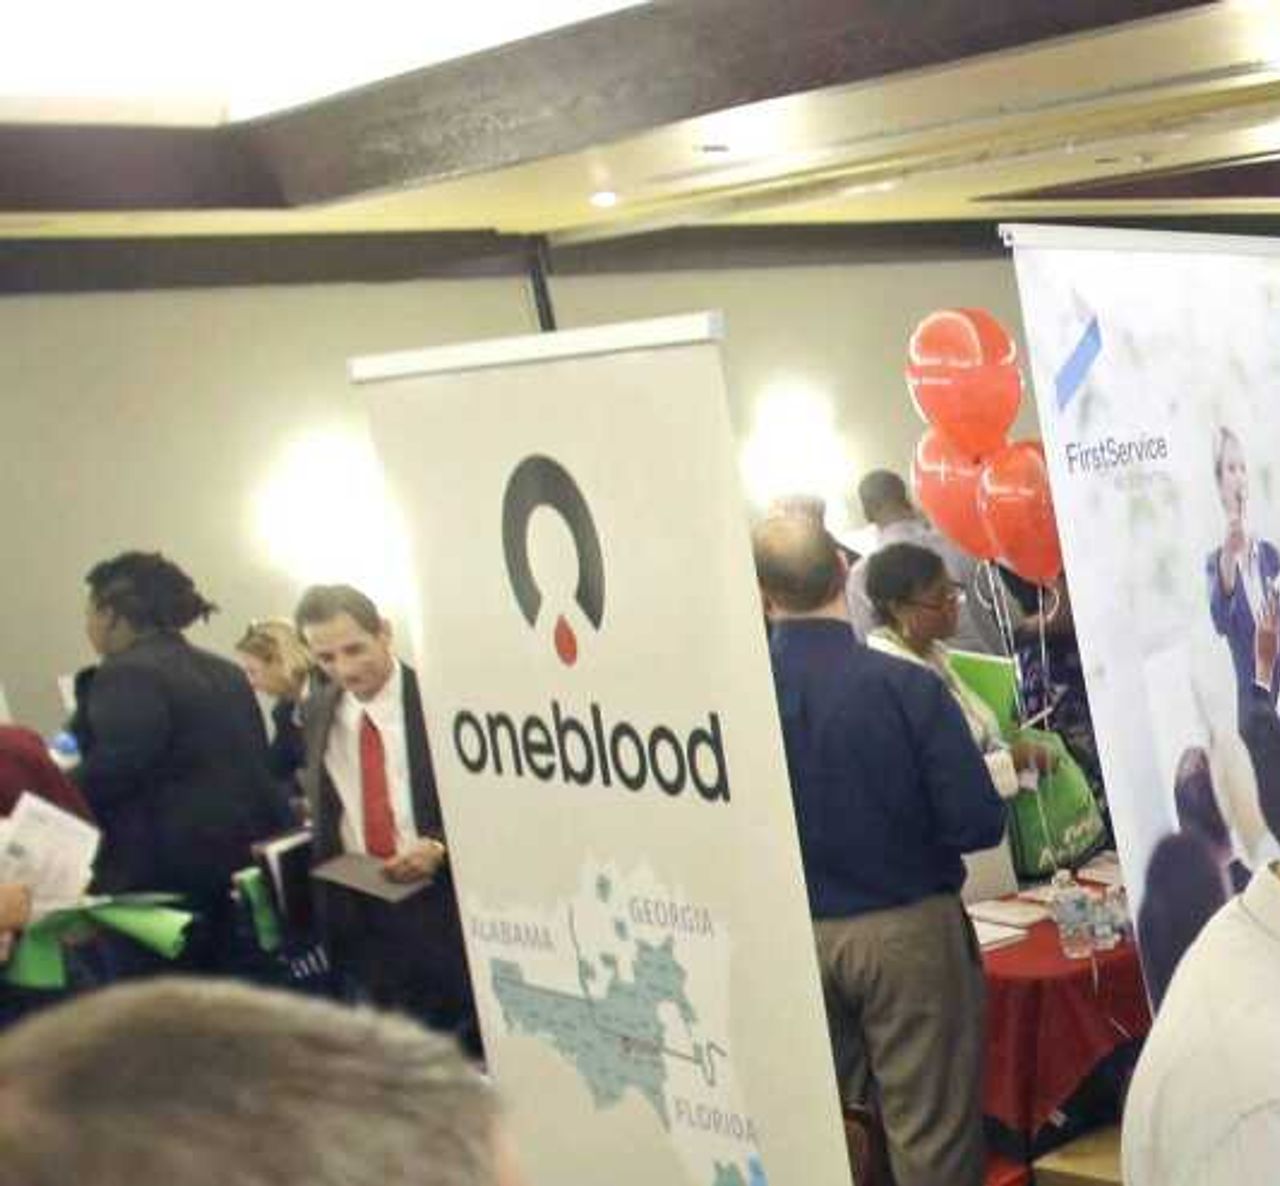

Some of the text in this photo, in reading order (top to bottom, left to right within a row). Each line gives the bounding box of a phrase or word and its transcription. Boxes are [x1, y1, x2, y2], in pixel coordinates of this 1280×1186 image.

[1065, 437, 1168, 475] FirstService
[453, 700, 731, 803] oneblood
[629, 899, 715, 938] GEORGIA
[675, 1099, 760, 1152] FLORIDA
